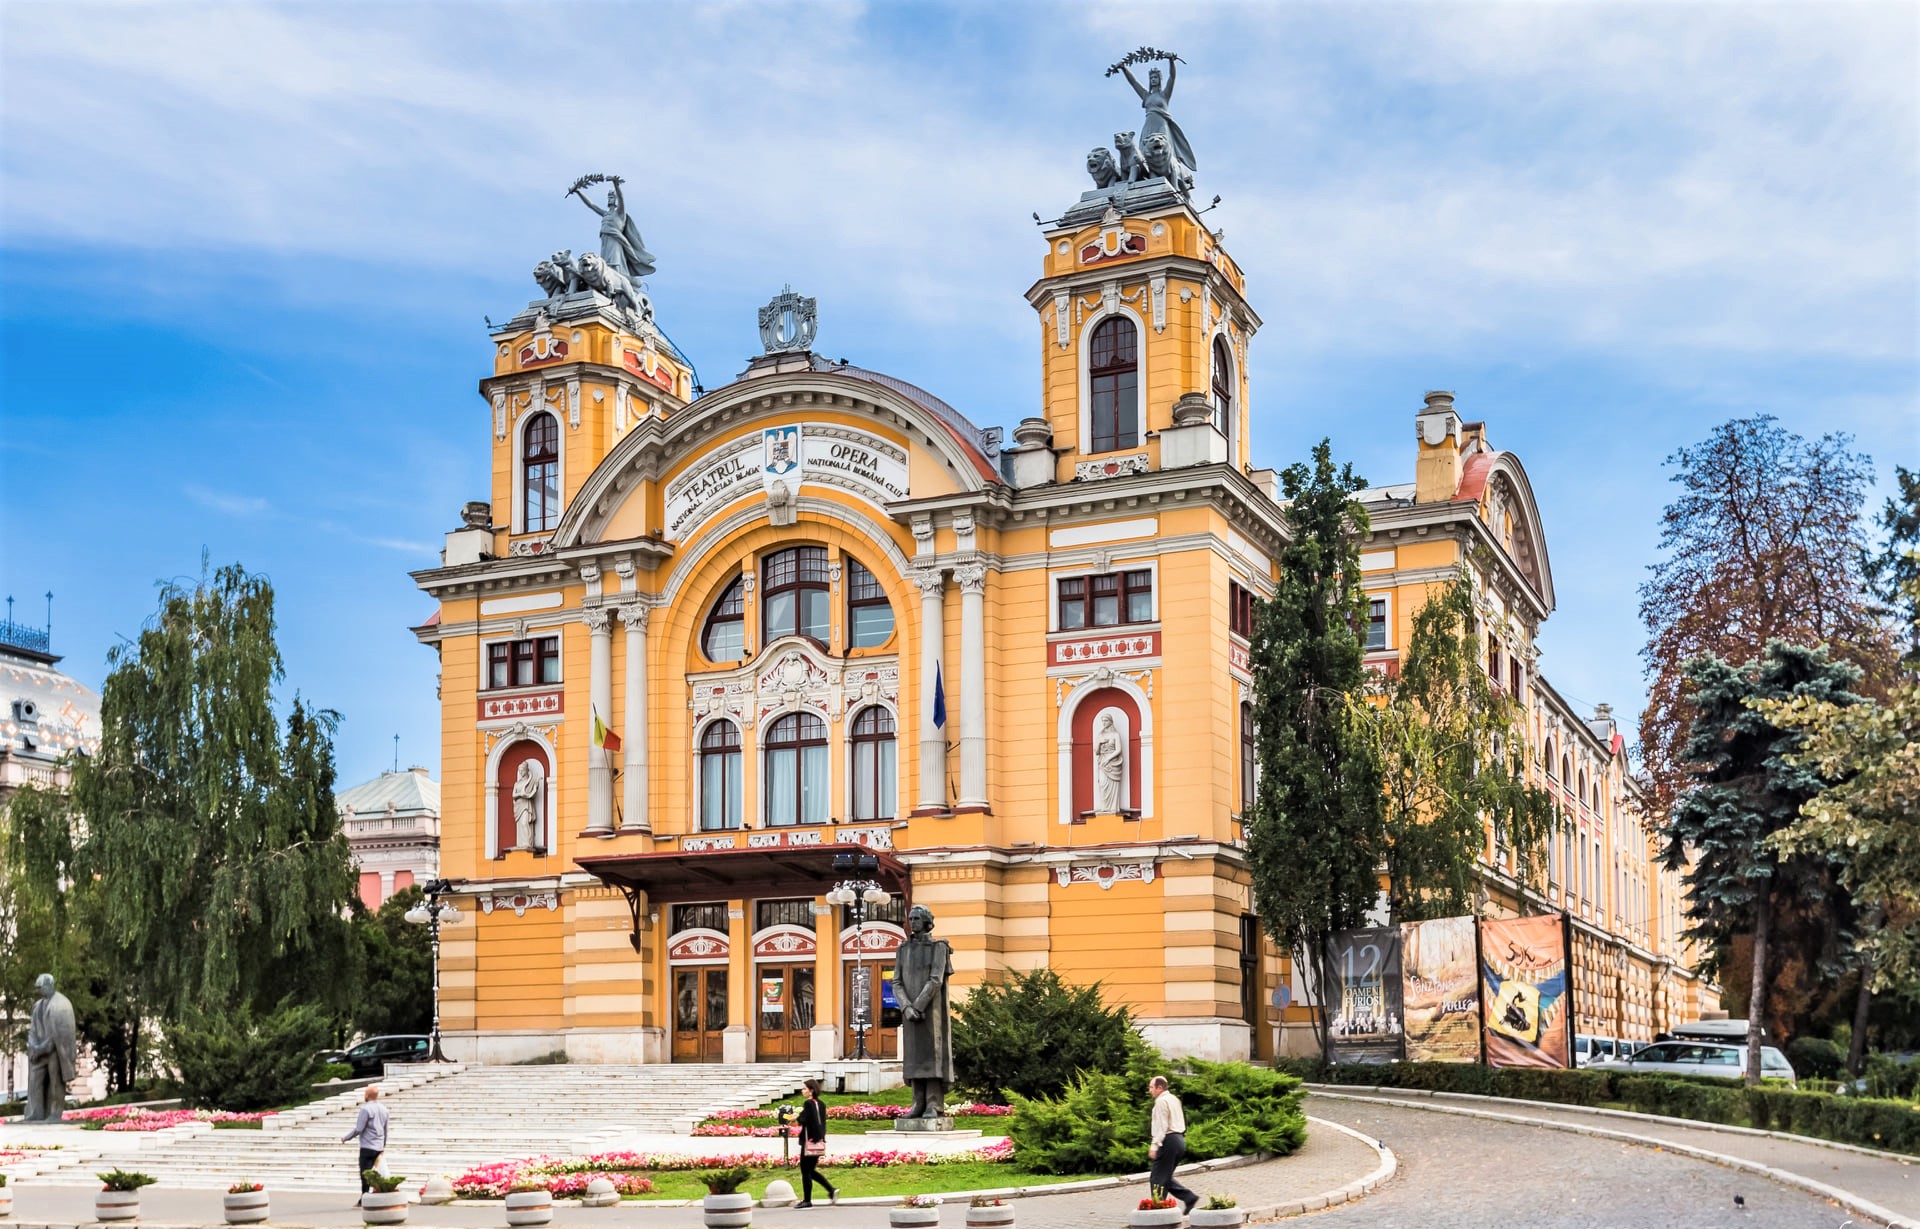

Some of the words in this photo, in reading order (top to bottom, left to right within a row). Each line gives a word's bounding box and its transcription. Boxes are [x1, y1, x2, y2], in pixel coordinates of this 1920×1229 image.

[830, 444, 878, 471] OPERA
[683, 458, 745, 502] TEATRUL
[885, 482, 903, 498] CLUJ
[1341, 944, 1382, 988] 12
[1345, 986, 1382, 997] OAMENI
